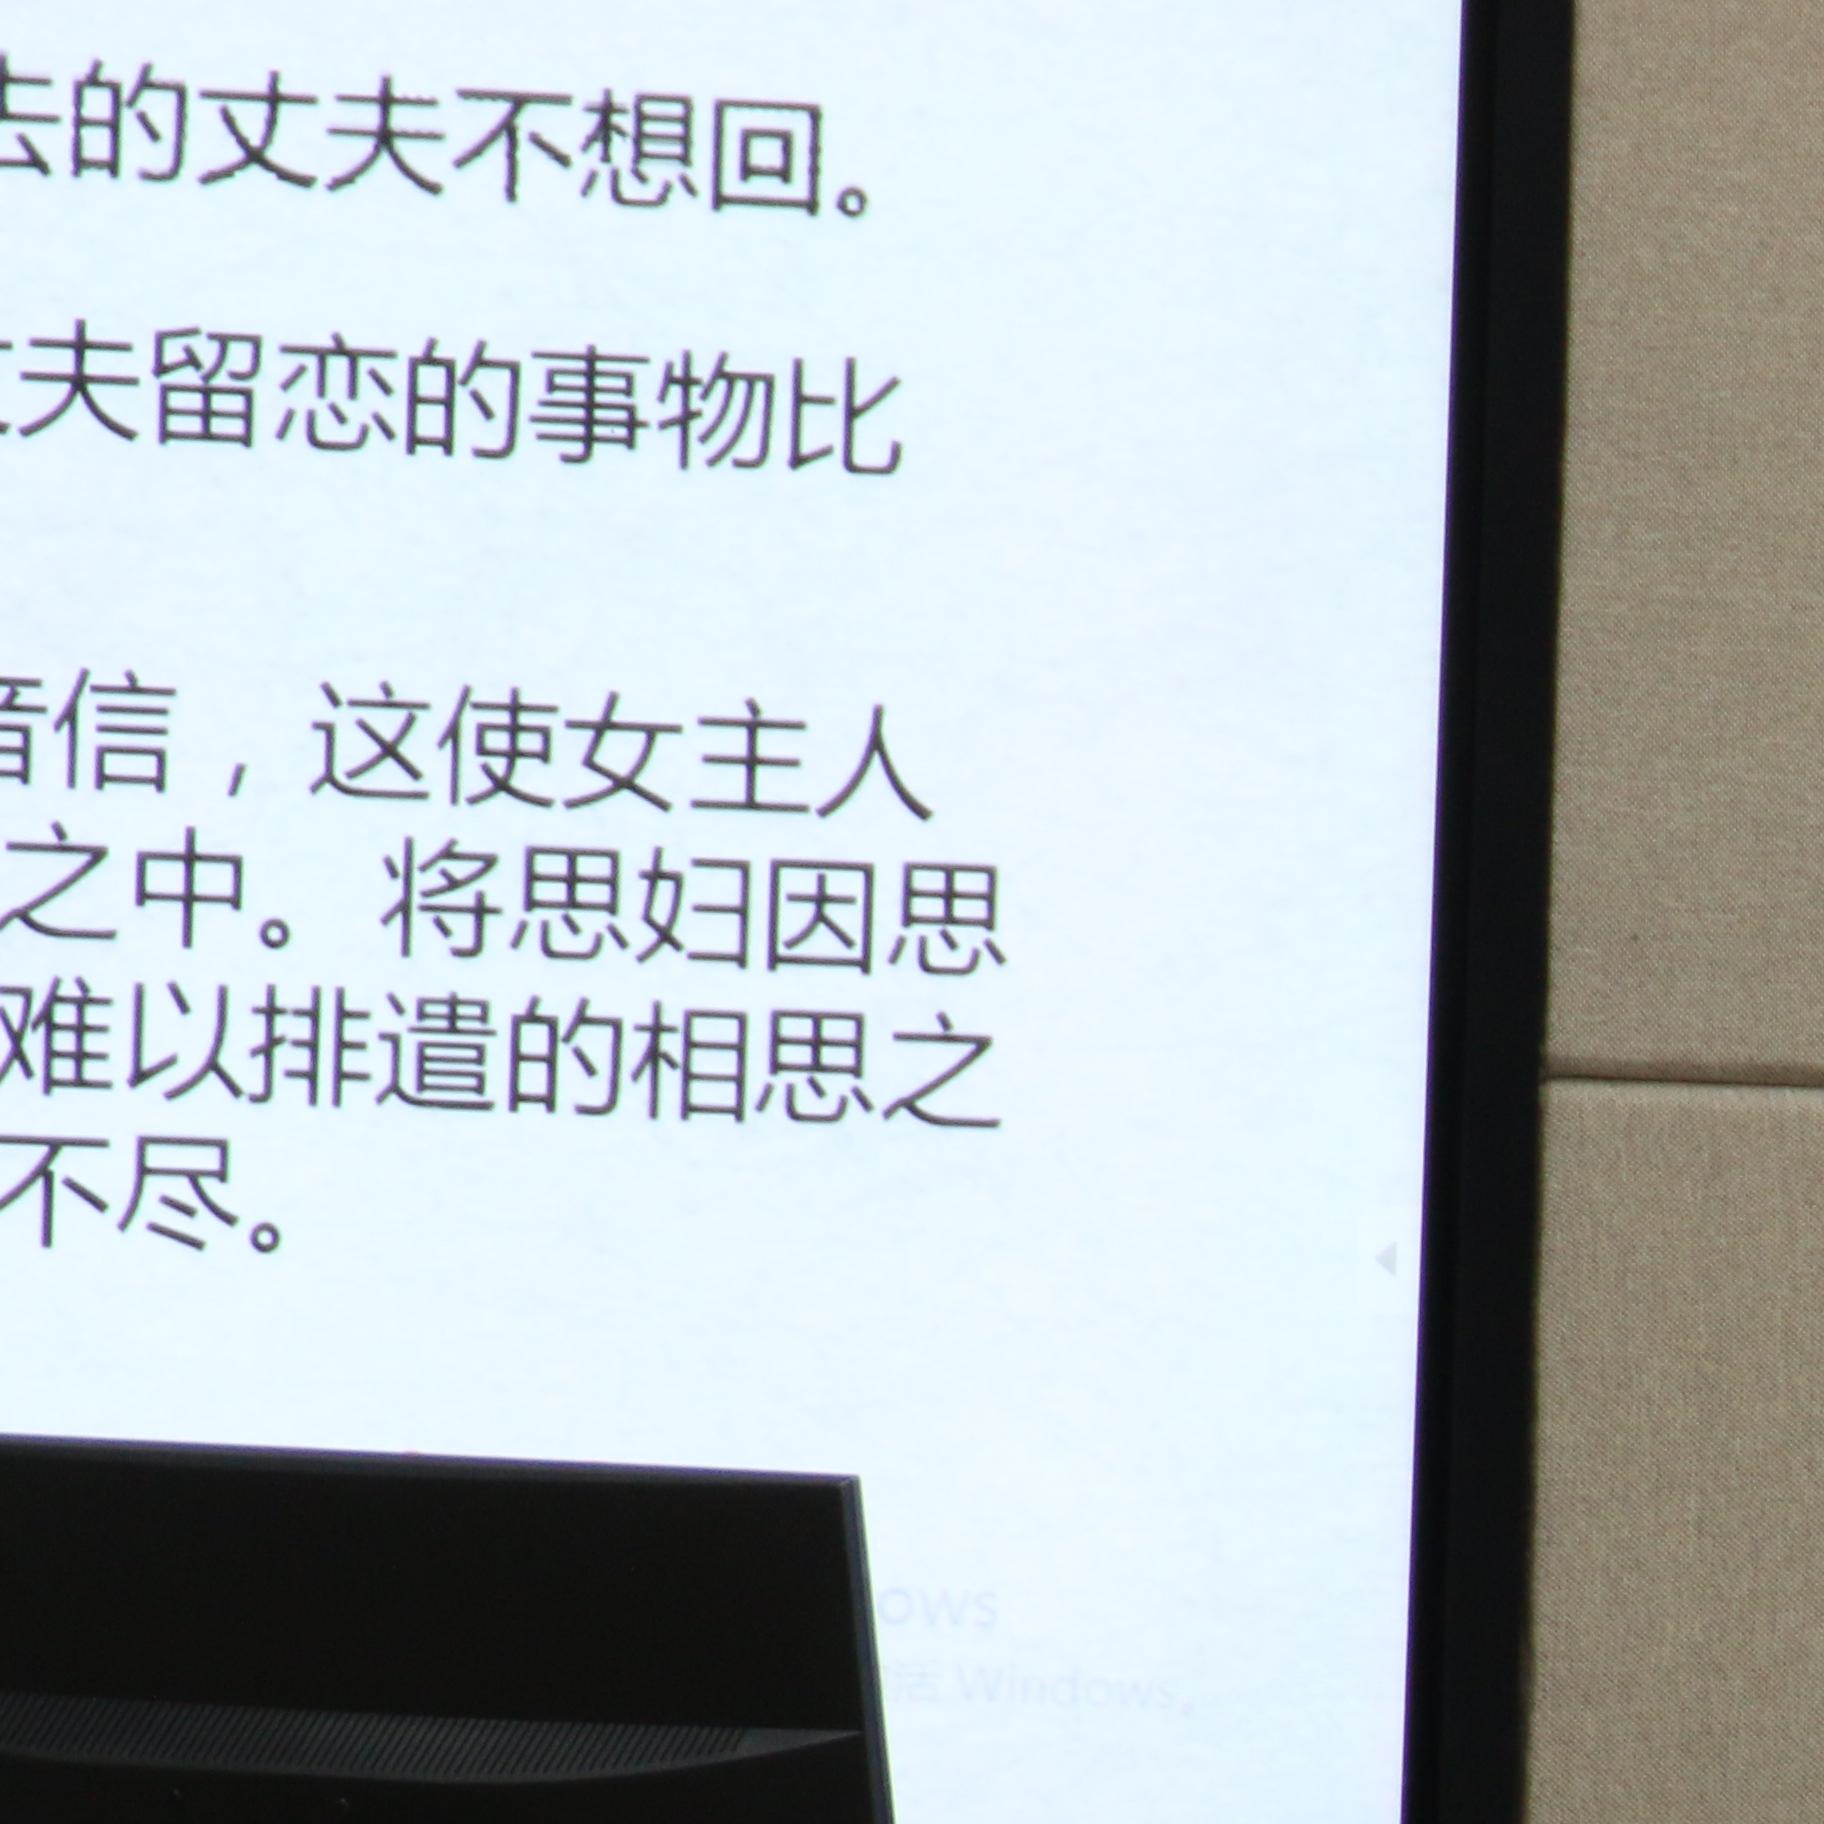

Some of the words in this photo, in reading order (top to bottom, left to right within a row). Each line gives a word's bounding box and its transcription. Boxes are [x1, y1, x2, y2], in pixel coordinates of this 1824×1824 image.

[0, 318, 903, 476] 夫留恋的事物比
[0, 976, 1001, 1130] 难以排遣的相思之
[0, 1134, 282, 1255] 不尽。
